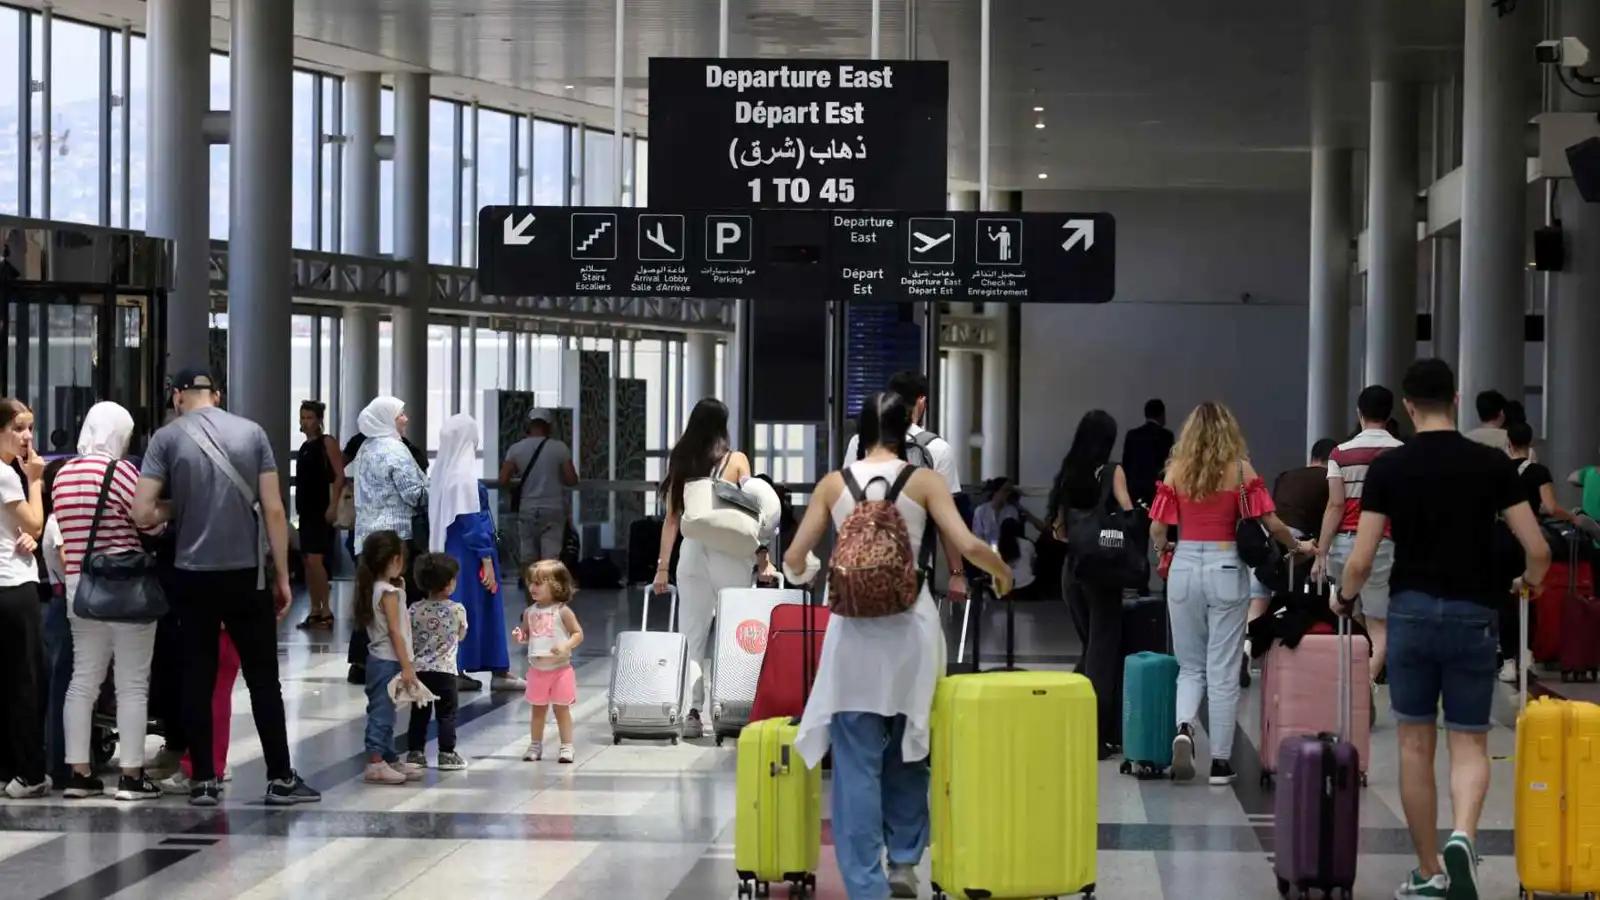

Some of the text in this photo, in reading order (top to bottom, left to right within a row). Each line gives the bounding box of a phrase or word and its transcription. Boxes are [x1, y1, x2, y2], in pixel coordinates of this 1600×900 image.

[705, 65, 893, 93] Departure East
[735, 100, 864, 129] Départ Est
[728, 135, 867, 169] ذهاب (شرق)
[747, 177, 855, 203] 1 TO 45
[833, 215, 894, 229] Departure
[716, 222, 742, 254] P
[850, 231, 877, 243] East
[636, 265, 686, 275] قاعة الوصول
[842, 267, 884, 281] Départ
[582, 273, 606, 282] Stairs
[633, 274, 689, 284] Arrival Lobby
[713, 275, 743, 285] Parking
[900, 276, 962, 287] Departure East
[575, 281, 612, 291] Escaliers
[630, 282, 652, 291] Salle
[853, 283, 873, 295] Est
[939, 286, 954, 295] Est
[967, 287, 1028, 297] Enregistrement
